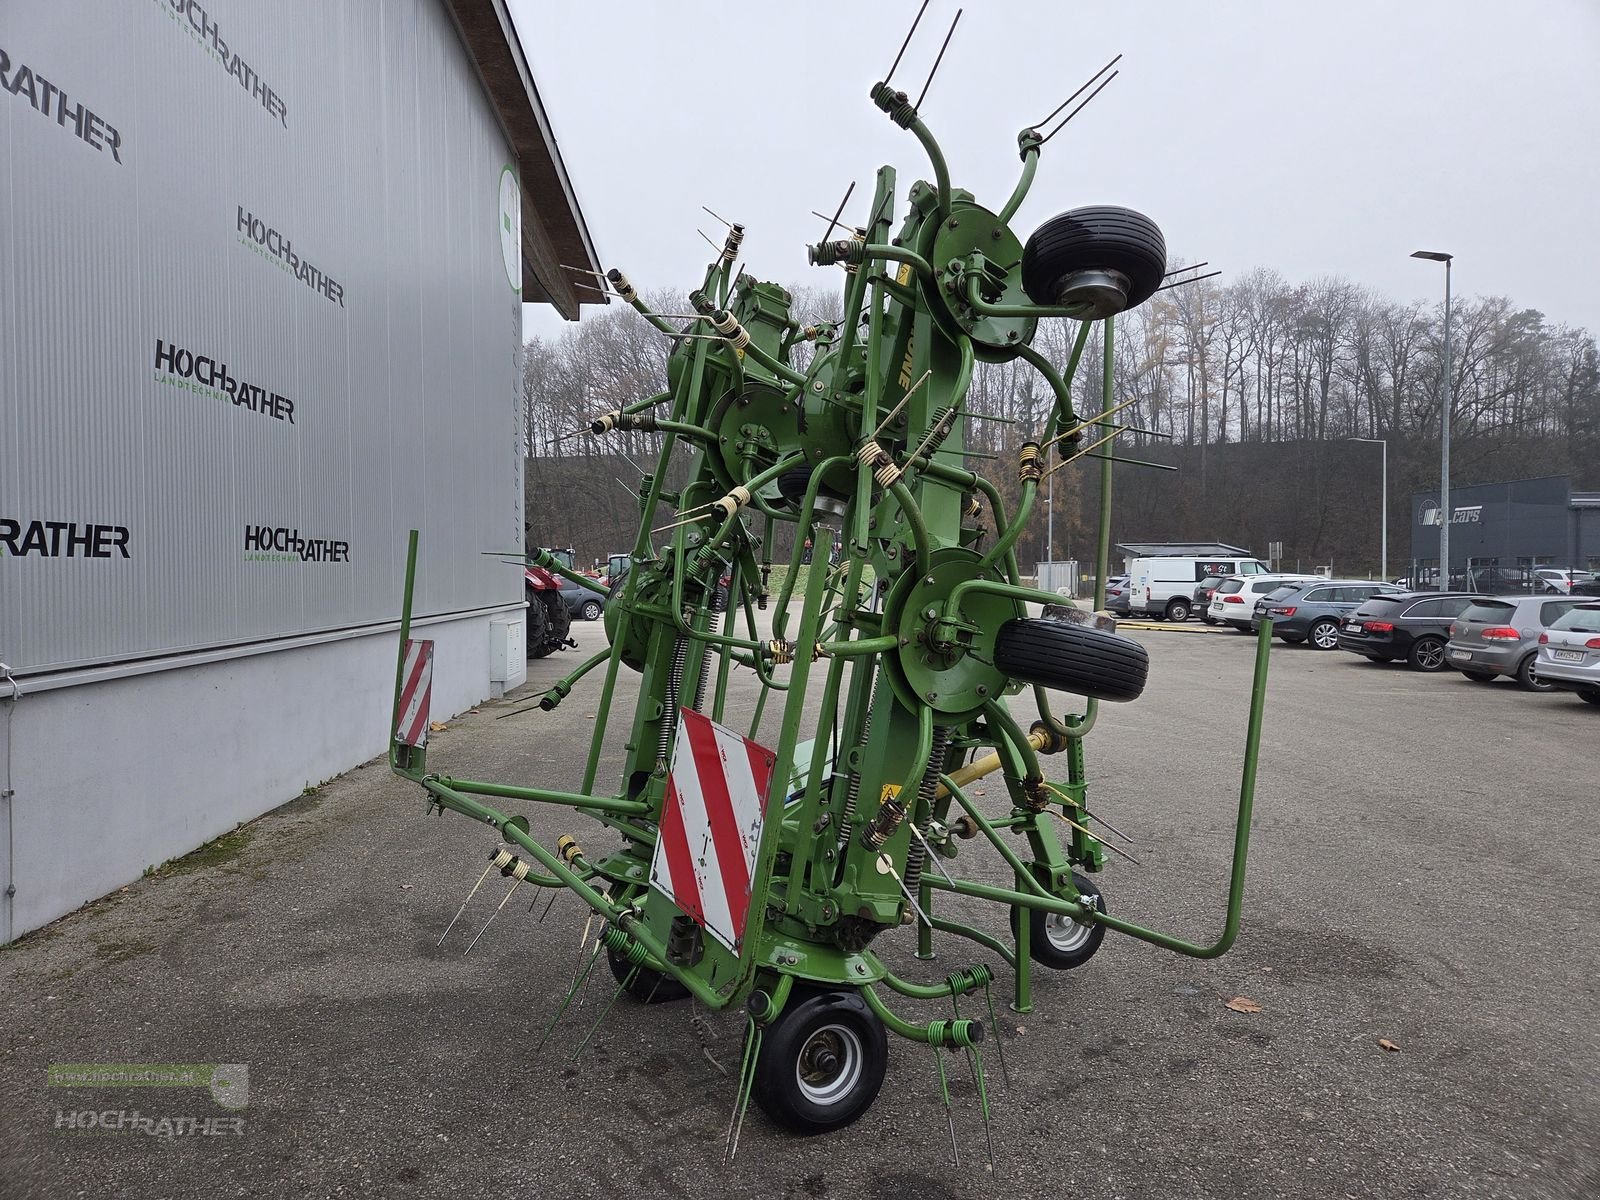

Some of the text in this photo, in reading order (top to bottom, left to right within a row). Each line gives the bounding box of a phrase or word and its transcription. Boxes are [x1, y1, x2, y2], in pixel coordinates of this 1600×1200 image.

[169, 0, 288, 129] CHRATHER
[237, 205, 344, 308] HOCHRATHER
[154, 372, 230, 403] LANDTECHNIK
[155, 339, 295, 425] HOCHRATHER
[245, 525, 349, 562] HOCHRATHER
